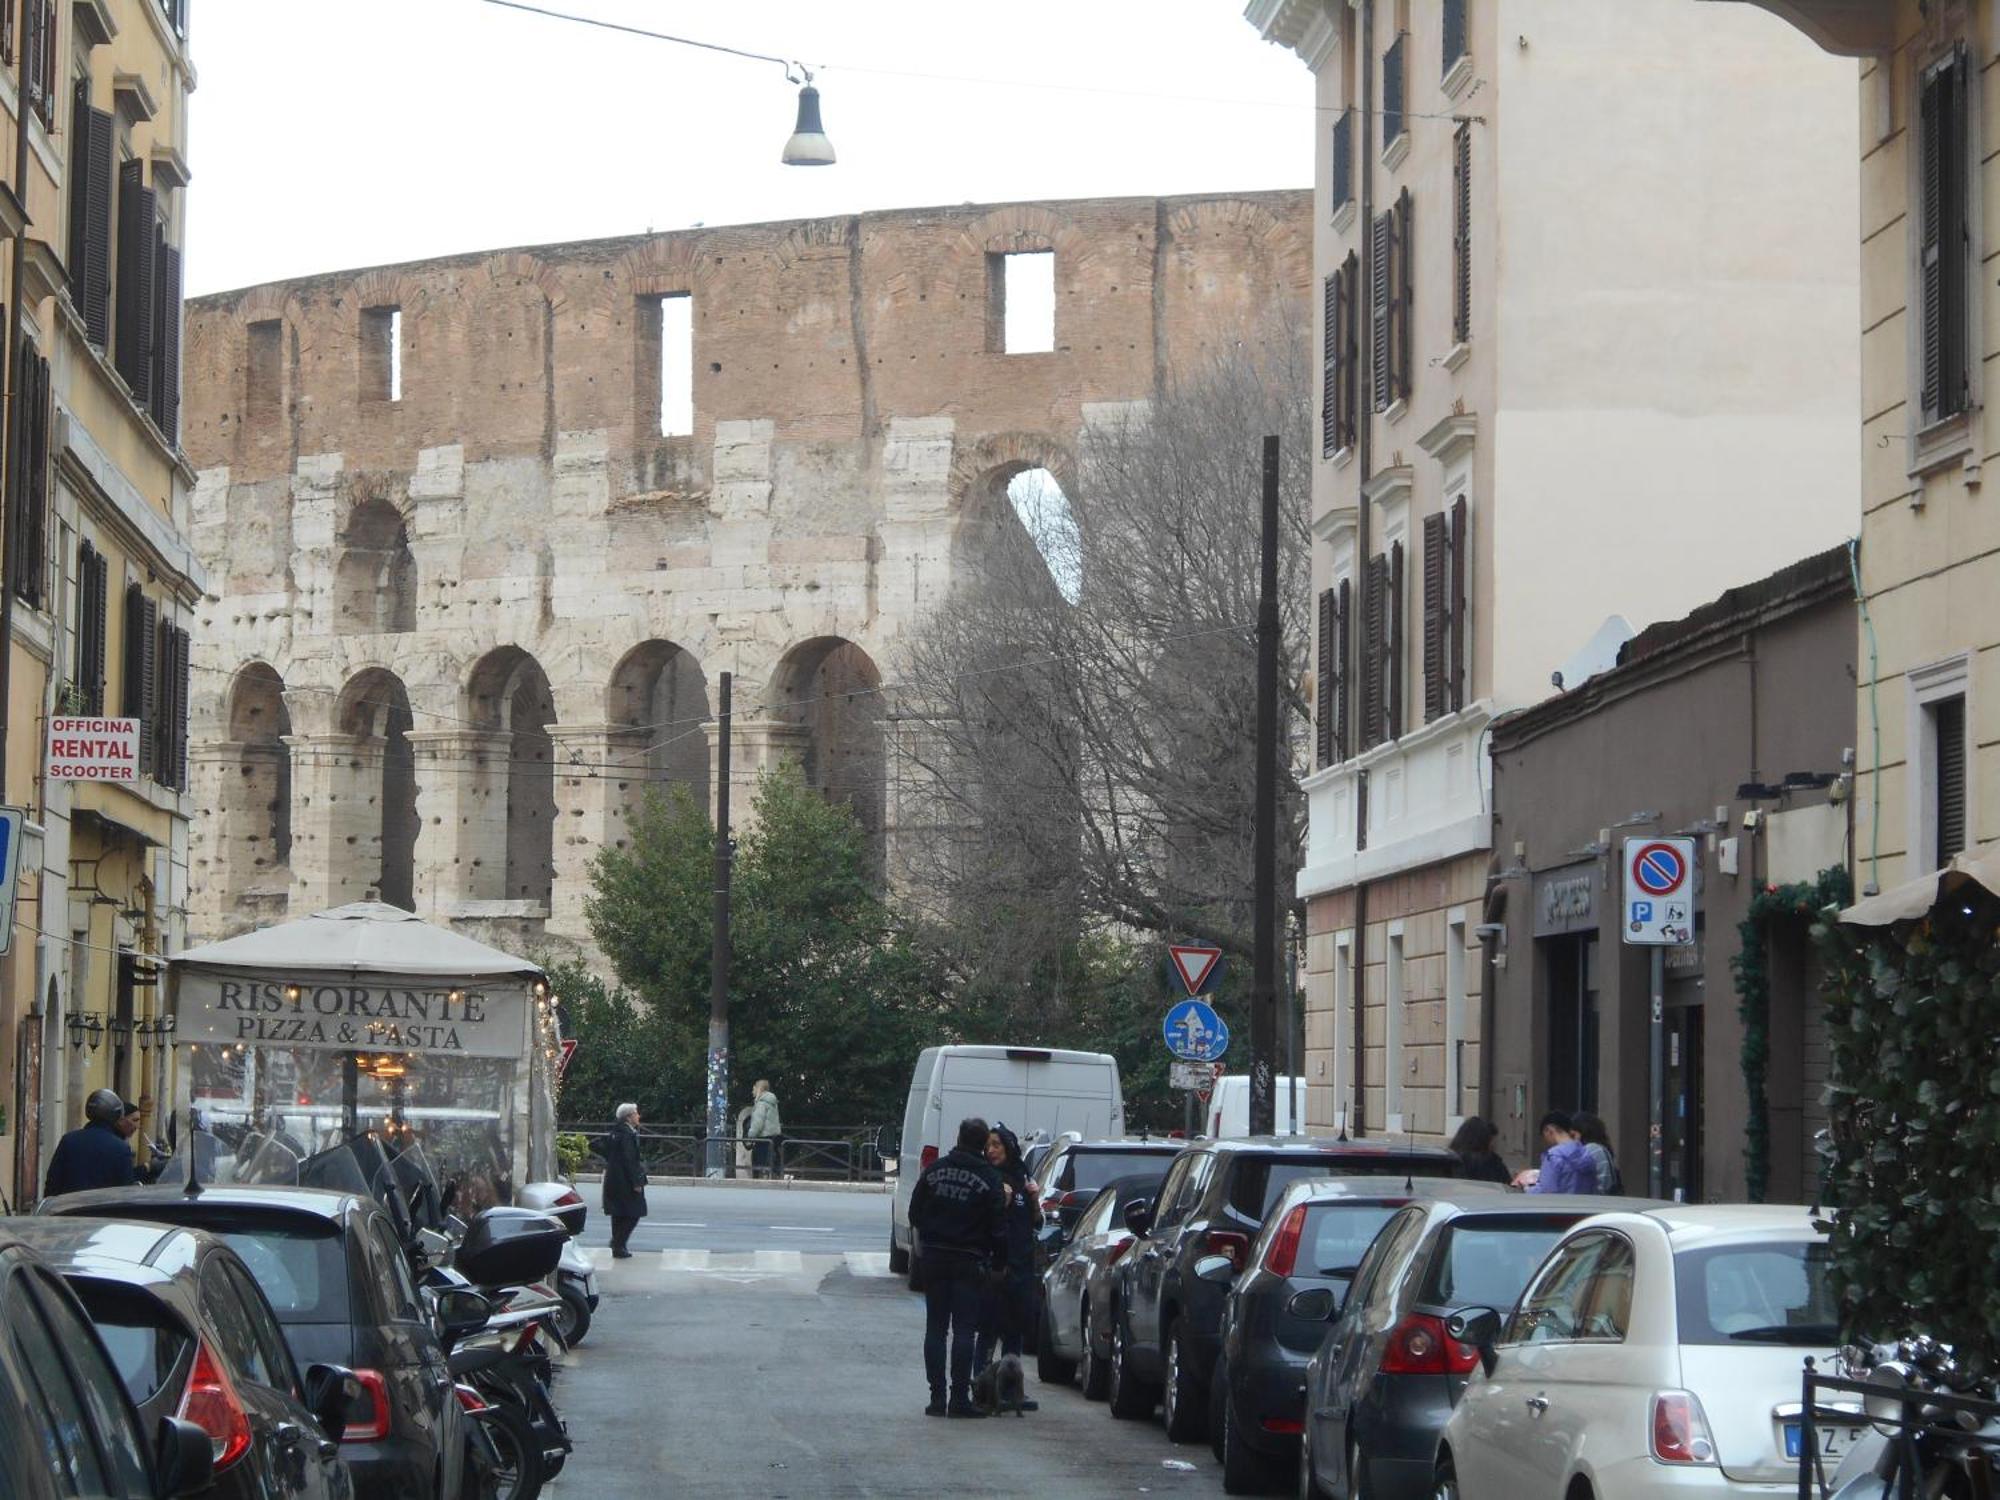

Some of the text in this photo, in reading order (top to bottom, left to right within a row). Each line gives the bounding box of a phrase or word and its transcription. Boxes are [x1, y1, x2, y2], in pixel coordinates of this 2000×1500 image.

[52, 719, 134, 733] OFFICINA
[51, 739, 134, 759] RENTAL
[50, 764, 133, 778] SCOOTER
[1636, 903, 1649, 920] P
[217, 981, 486, 1023] RISTORANTE
[236, 1016, 463, 1050] PIZZA & PASTA
[926, 1167, 991, 1193] SCHOTT
[935, 1182, 971, 1201] NYC
